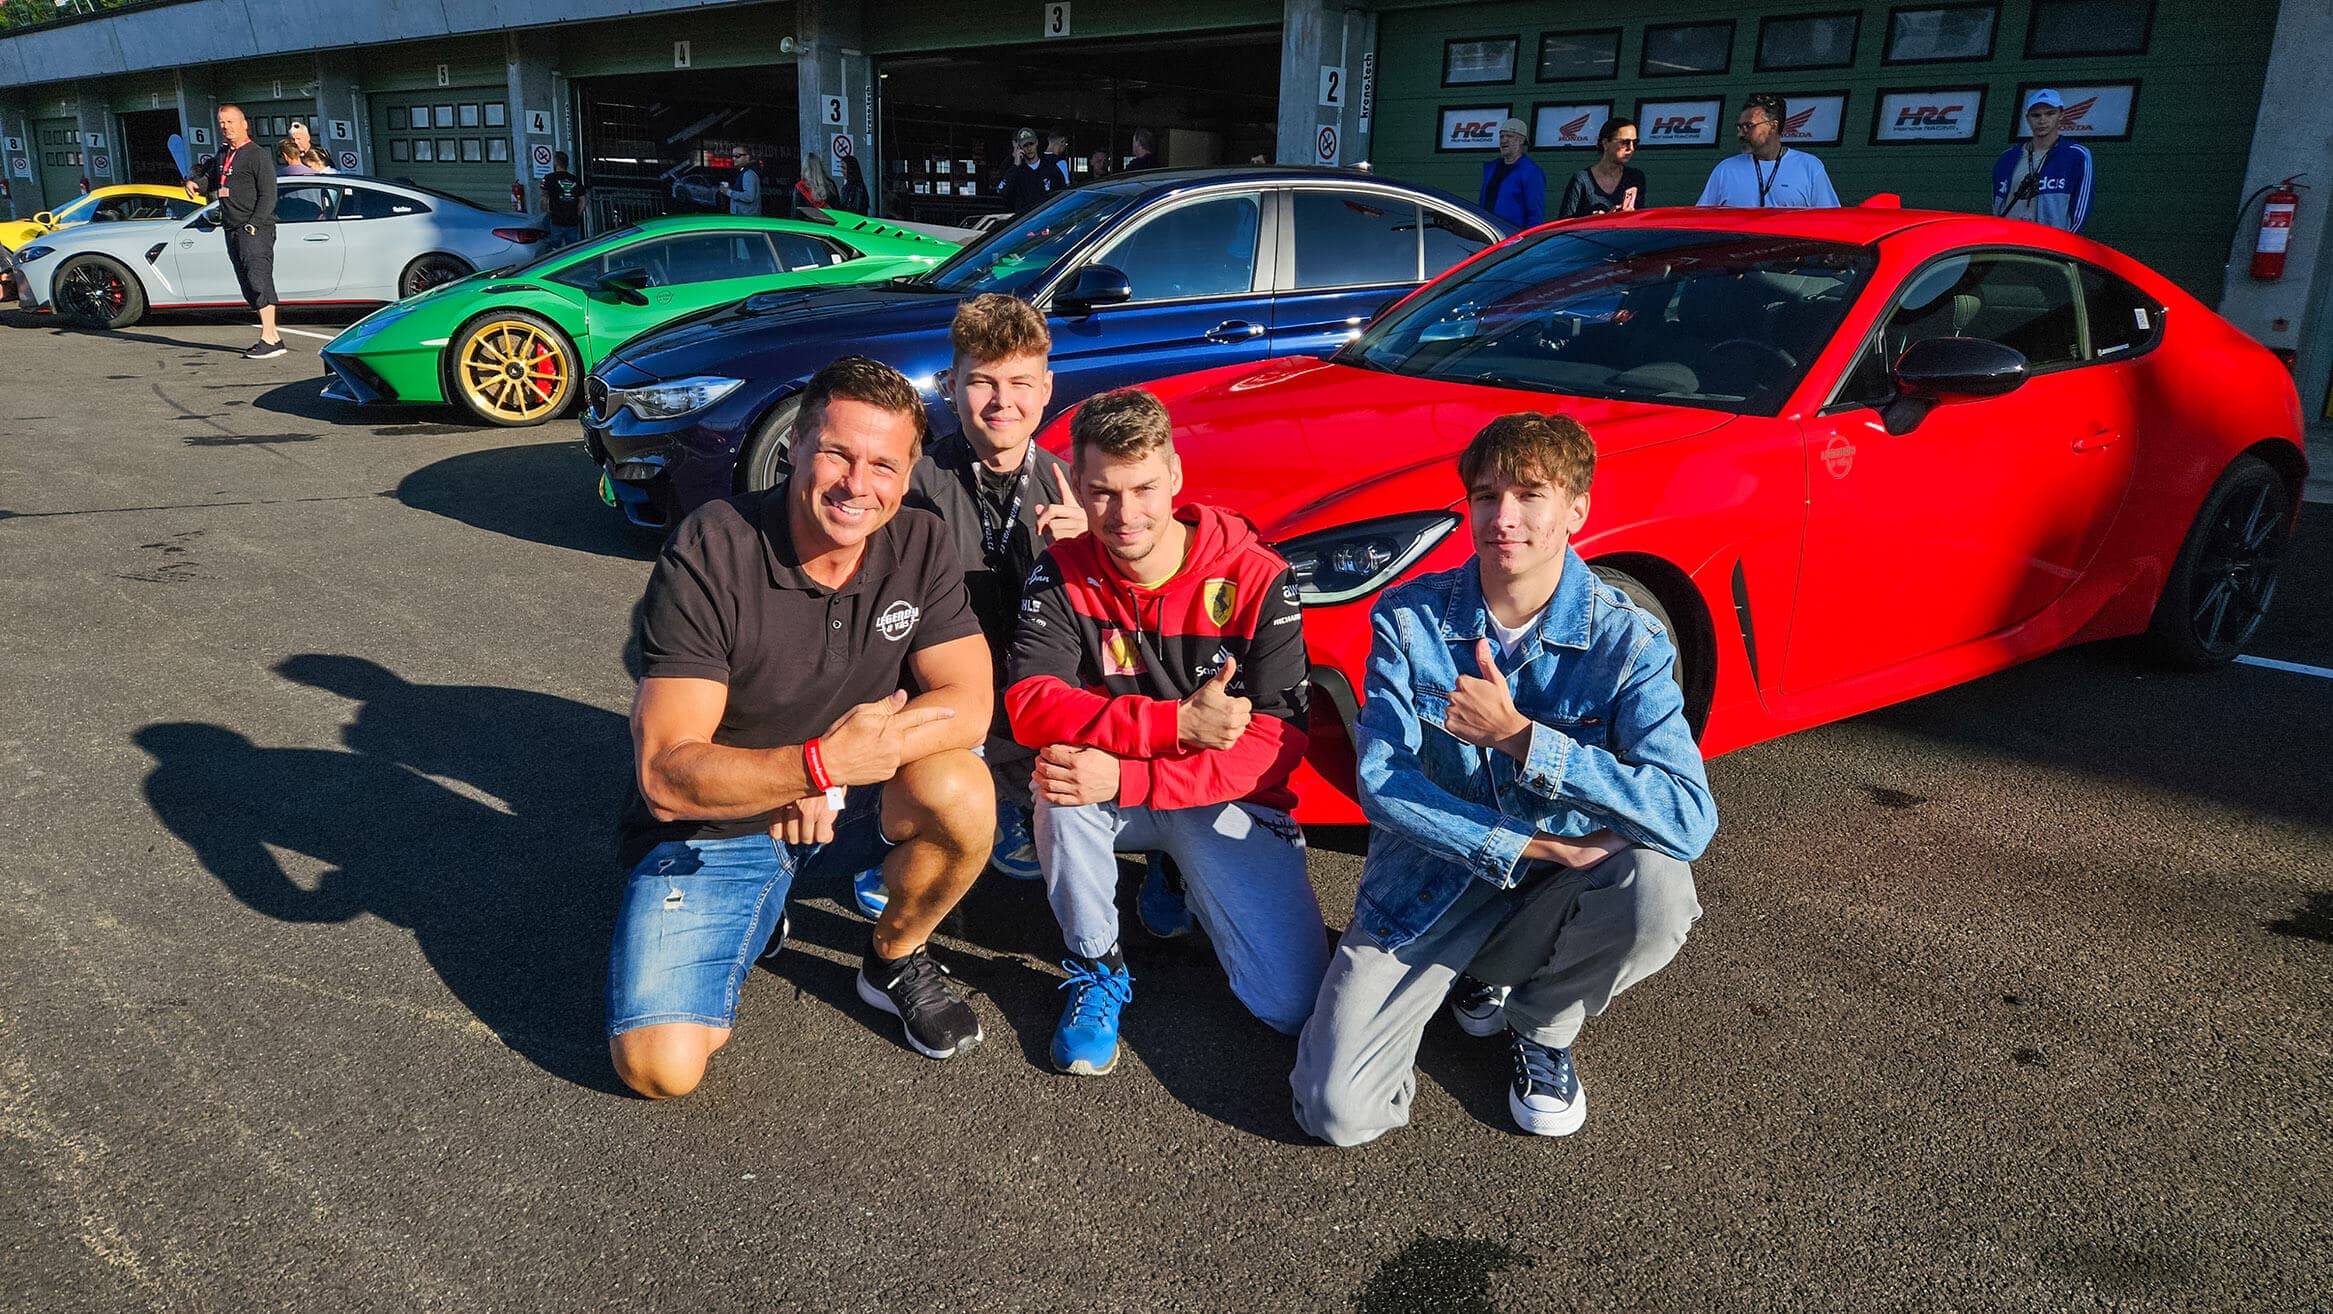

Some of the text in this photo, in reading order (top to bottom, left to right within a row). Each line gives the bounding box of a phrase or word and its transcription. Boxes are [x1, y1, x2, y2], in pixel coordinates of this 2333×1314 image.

[1052, 5, 1063, 33] 3
[679, 43, 686, 65] 4
[440, 66, 446, 84] 5
[1327, 70, 1339, 103] 2
[830, 98, 842, 123] 3
[1895, 105, 1964, 125] HRC
[335, 122, 346, 138] 5
[533, 112, 545, 132] 4
[1451, 121, 1498, 138] HRC
[1651, 116, 1706, 134] HRC
[10, 138, 18, 149] 8
[90, 134, 99, 146] 7
[195, 129, 205, 144] 6
